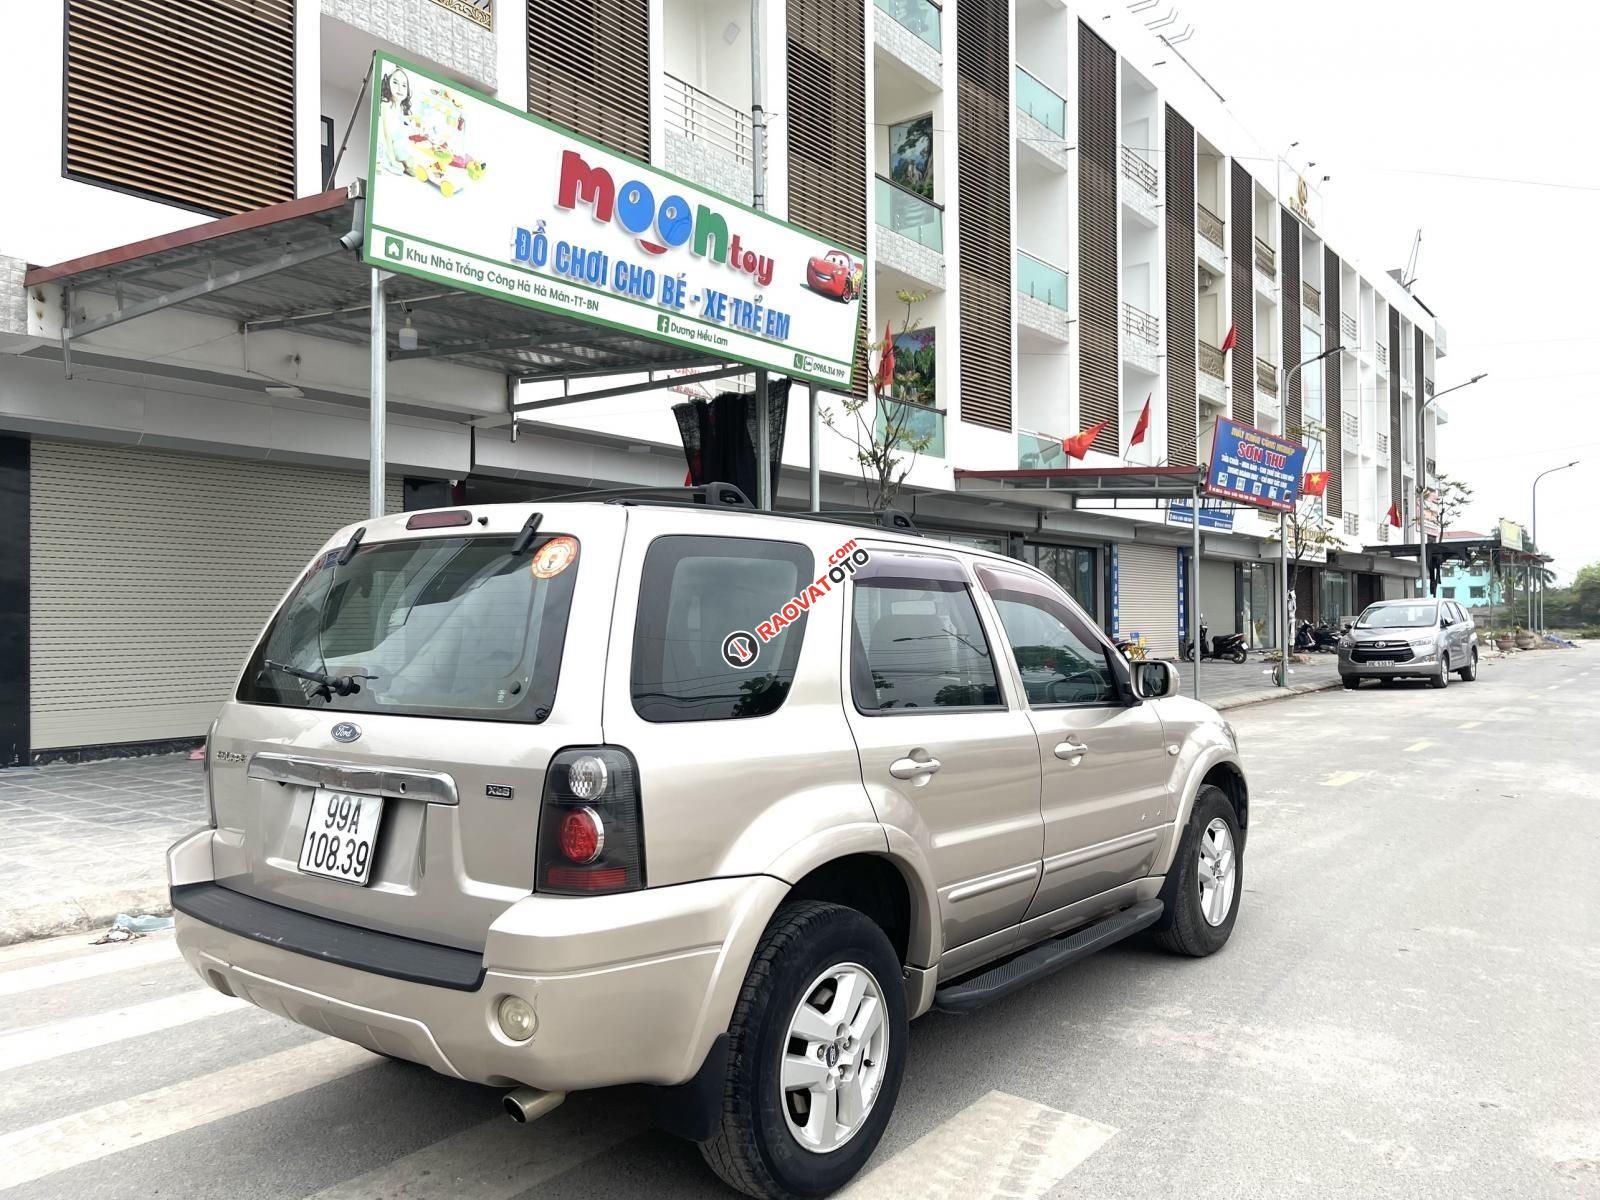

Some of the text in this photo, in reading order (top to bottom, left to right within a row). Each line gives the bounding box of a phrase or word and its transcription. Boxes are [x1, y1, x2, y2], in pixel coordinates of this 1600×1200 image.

[556, 149, 775, 287] moon toy
[406, 247, 428, 265] Khu
[430, 254, 453, 271] Nhà
[487, 270, 515, 290] Công
[517, 279, 531, 292] Hà
[534, 283, 547, 297] Hà
[513, 219, 549, 267] ĐỒ
[554, 241, 609, 286] CHƠI
[613, 260, 656, 299] CHO
[661, 273, 687, 309] BÉ
[702, 288, 728, 322] XE
[730, 294, 763, 331] TRẺ
[766, 310, 791, 340] EM
[713, 334, 728, 346] Lam
[324, 794, 363, 835] 99A
[306, 830, 369, 878] 108.39
